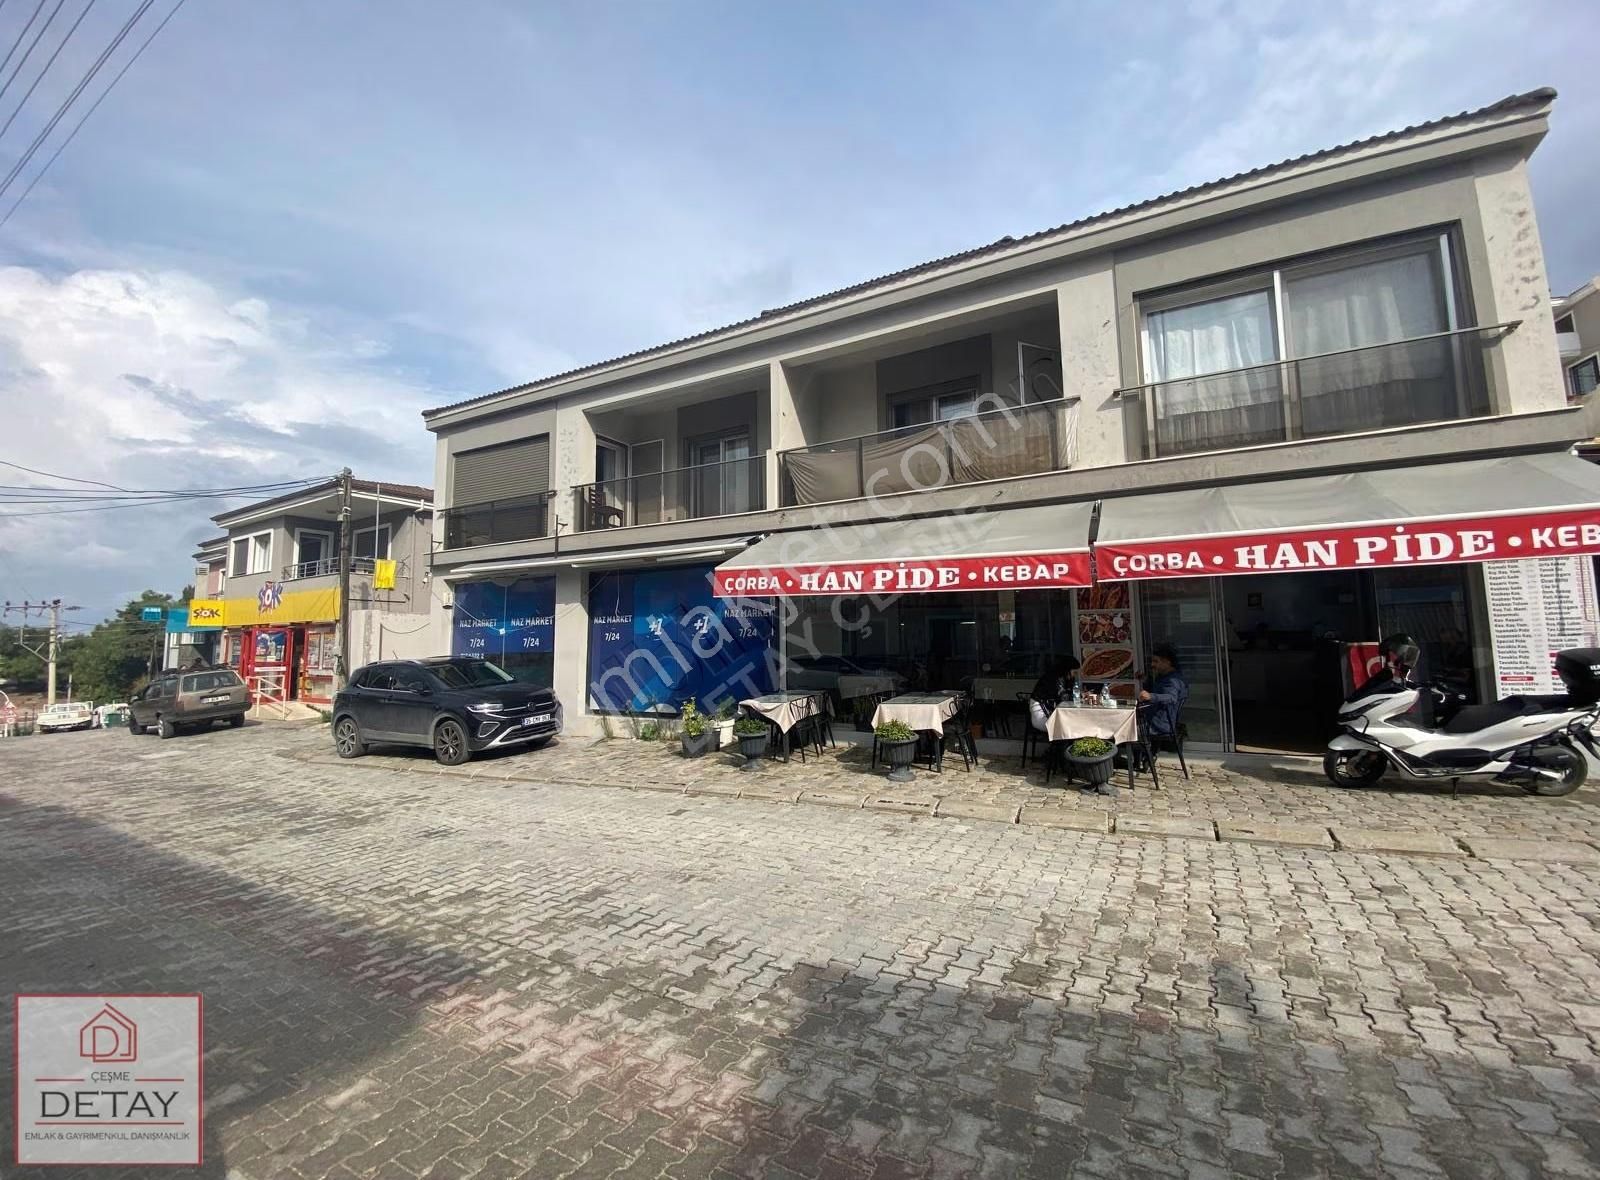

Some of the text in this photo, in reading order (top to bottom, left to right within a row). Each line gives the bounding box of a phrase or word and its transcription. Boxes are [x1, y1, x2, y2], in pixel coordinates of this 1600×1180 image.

[1113, 551, 1204, 575] ÇORBA
[1234, 540, 1338, 569] HAN
[1353, 526, 1496, 564] PİDE
[1531, 524, 1600, 549] KEB
[724, 562, 1069, 593] ÇORBA HAN PİDE KEBAP
[724, 607, 773, 618] NAZ MARKET
[460, 618, 497, 628] NAZ MARKET
[511, 616, 554, 627] NAZ MARKET
[594, 614, 633, 624] NAZ MARKET
[605, 632, 620, 641] 7/24
[739, 628, 758, 637] 7/24
[470, 637, 485, 648] 7/24
[523, 637, 540, 648] 7/24
